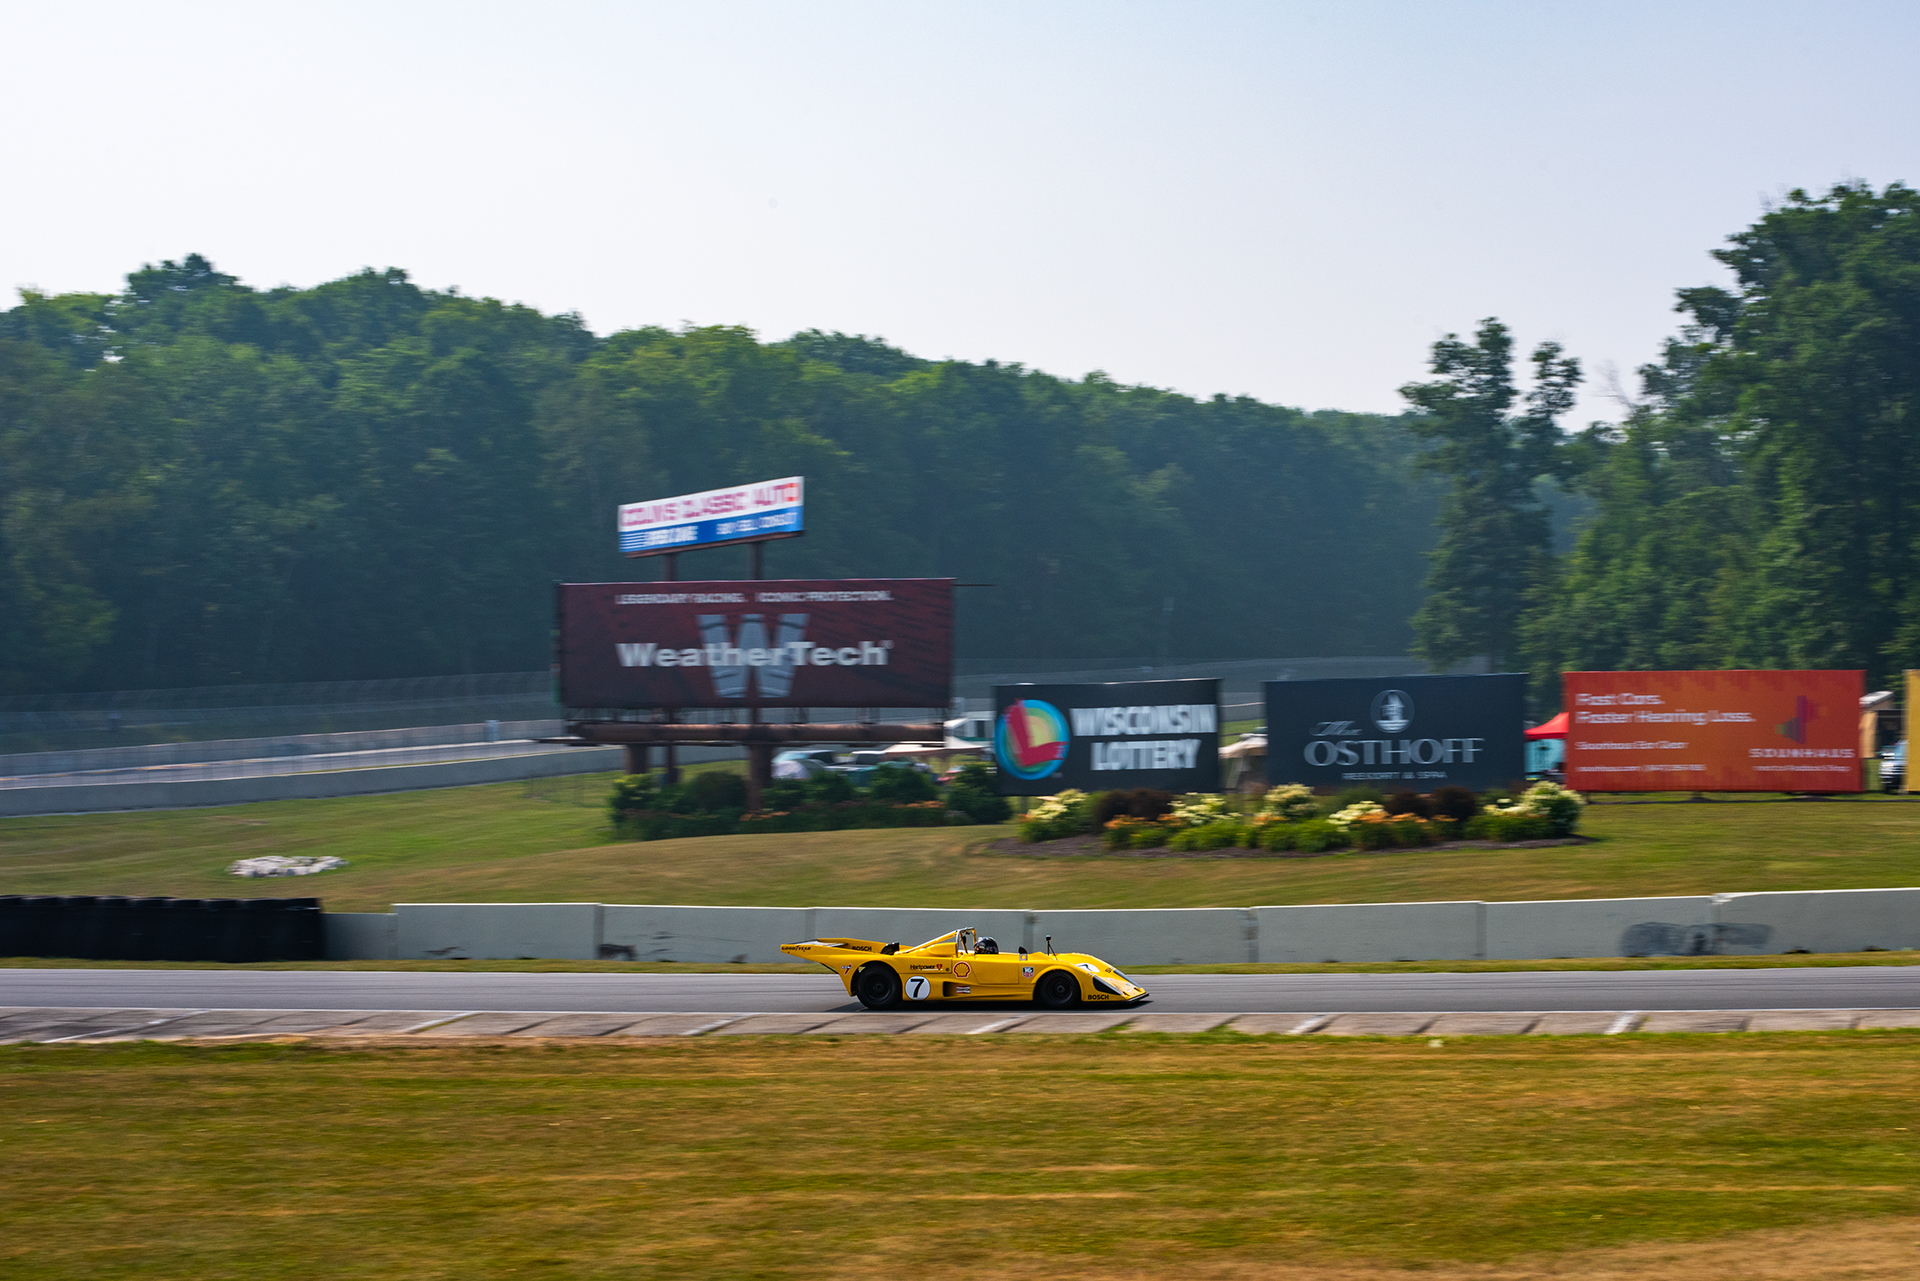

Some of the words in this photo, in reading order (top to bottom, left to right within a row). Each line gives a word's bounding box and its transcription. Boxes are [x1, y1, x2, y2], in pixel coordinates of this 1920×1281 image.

[1069, 704, 1217, 737] WISCONSIN
[1090, 738, 1202, 771] LOTTERY
[1304, 738, 1486, 767] OSTHOFF
[910, 978, 925, 998] 7
